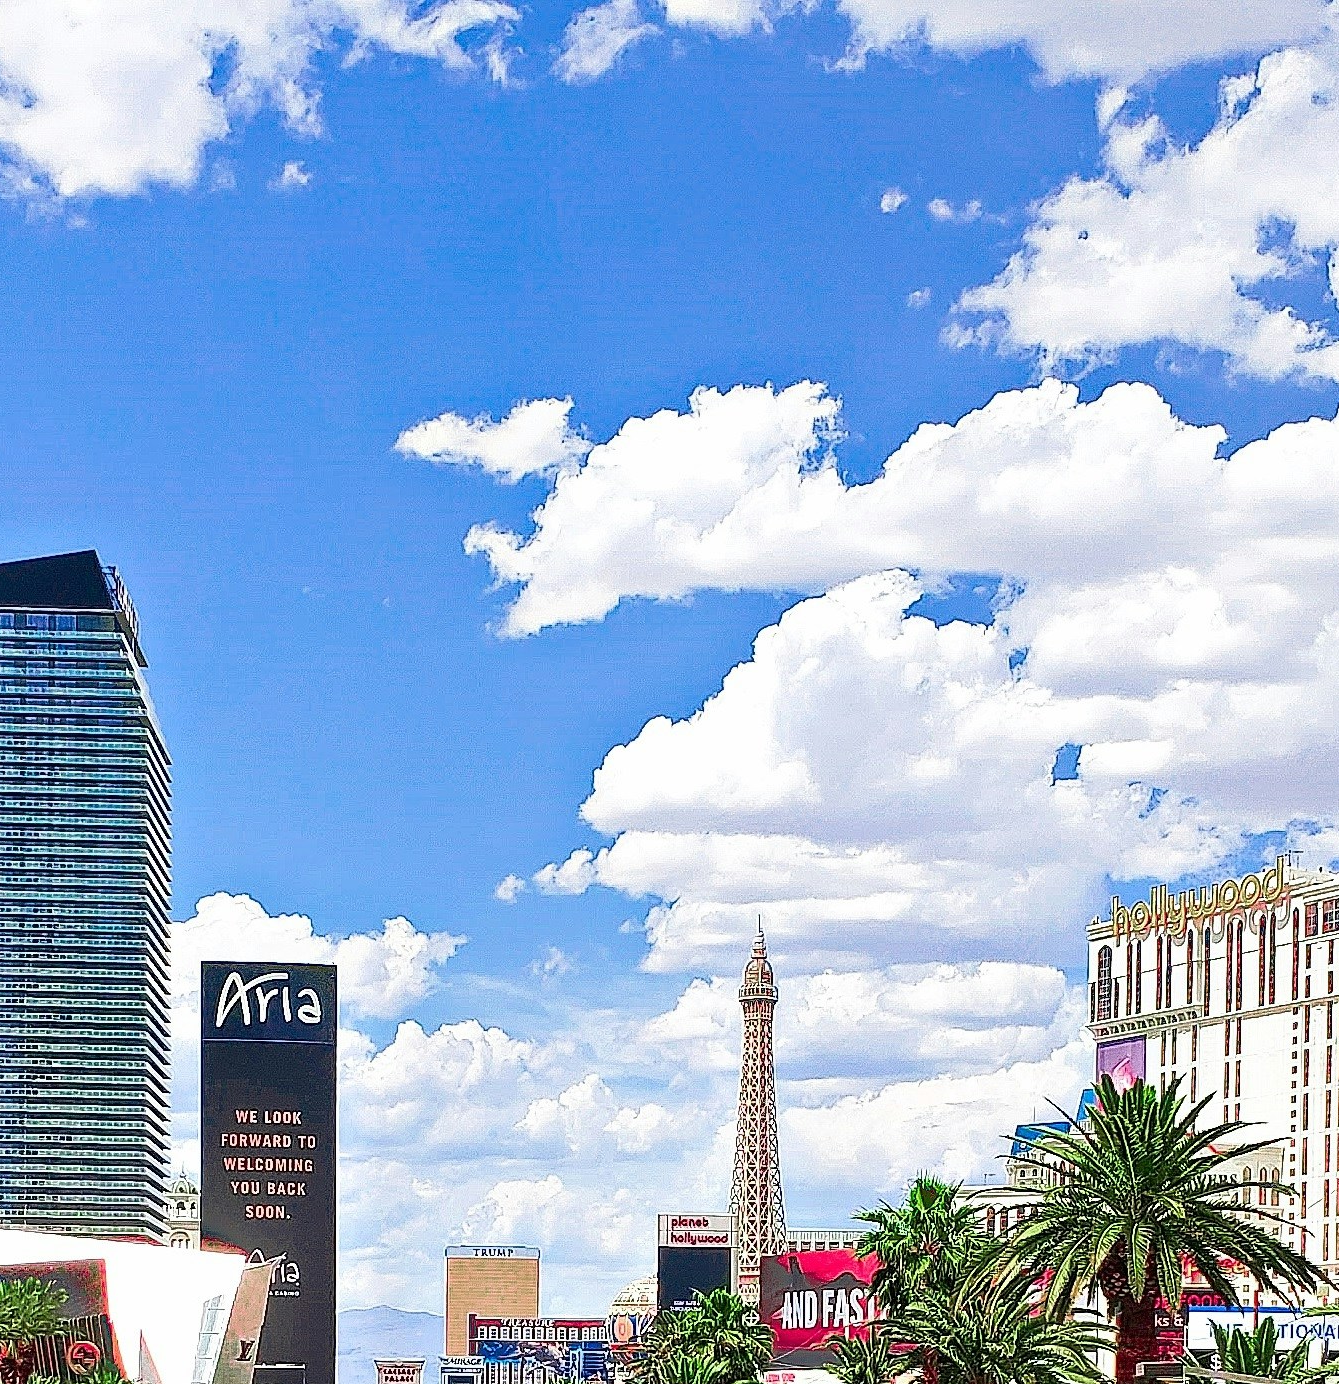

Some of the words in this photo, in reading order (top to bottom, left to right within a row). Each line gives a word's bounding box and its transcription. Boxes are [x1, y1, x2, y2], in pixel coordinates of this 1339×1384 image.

[1112, 855, 1285, 937] hollywood
[215, 972, 322, 1028] Aria
[235, 1110, 258, 1124] WE
[264, 1111, 302, 1125] LOOK
[221, 1133, 292, 1148] FORWARD
[298, 1135, 316, 1149] TO
[223, 1157, 314, 1172] WELCOMING
[230, 1181, 260, 1195] YOU
[267, 1182, 306, 1196] BACK
[245, 1205, 292, 1220] SOON.
[671, 1215, 709, 1231] planet
[671, 1232, 729, 1245] hollywood
[473, 1248, 514, 1257] TRUMP
[782, 1290, 818, 1330] AND
